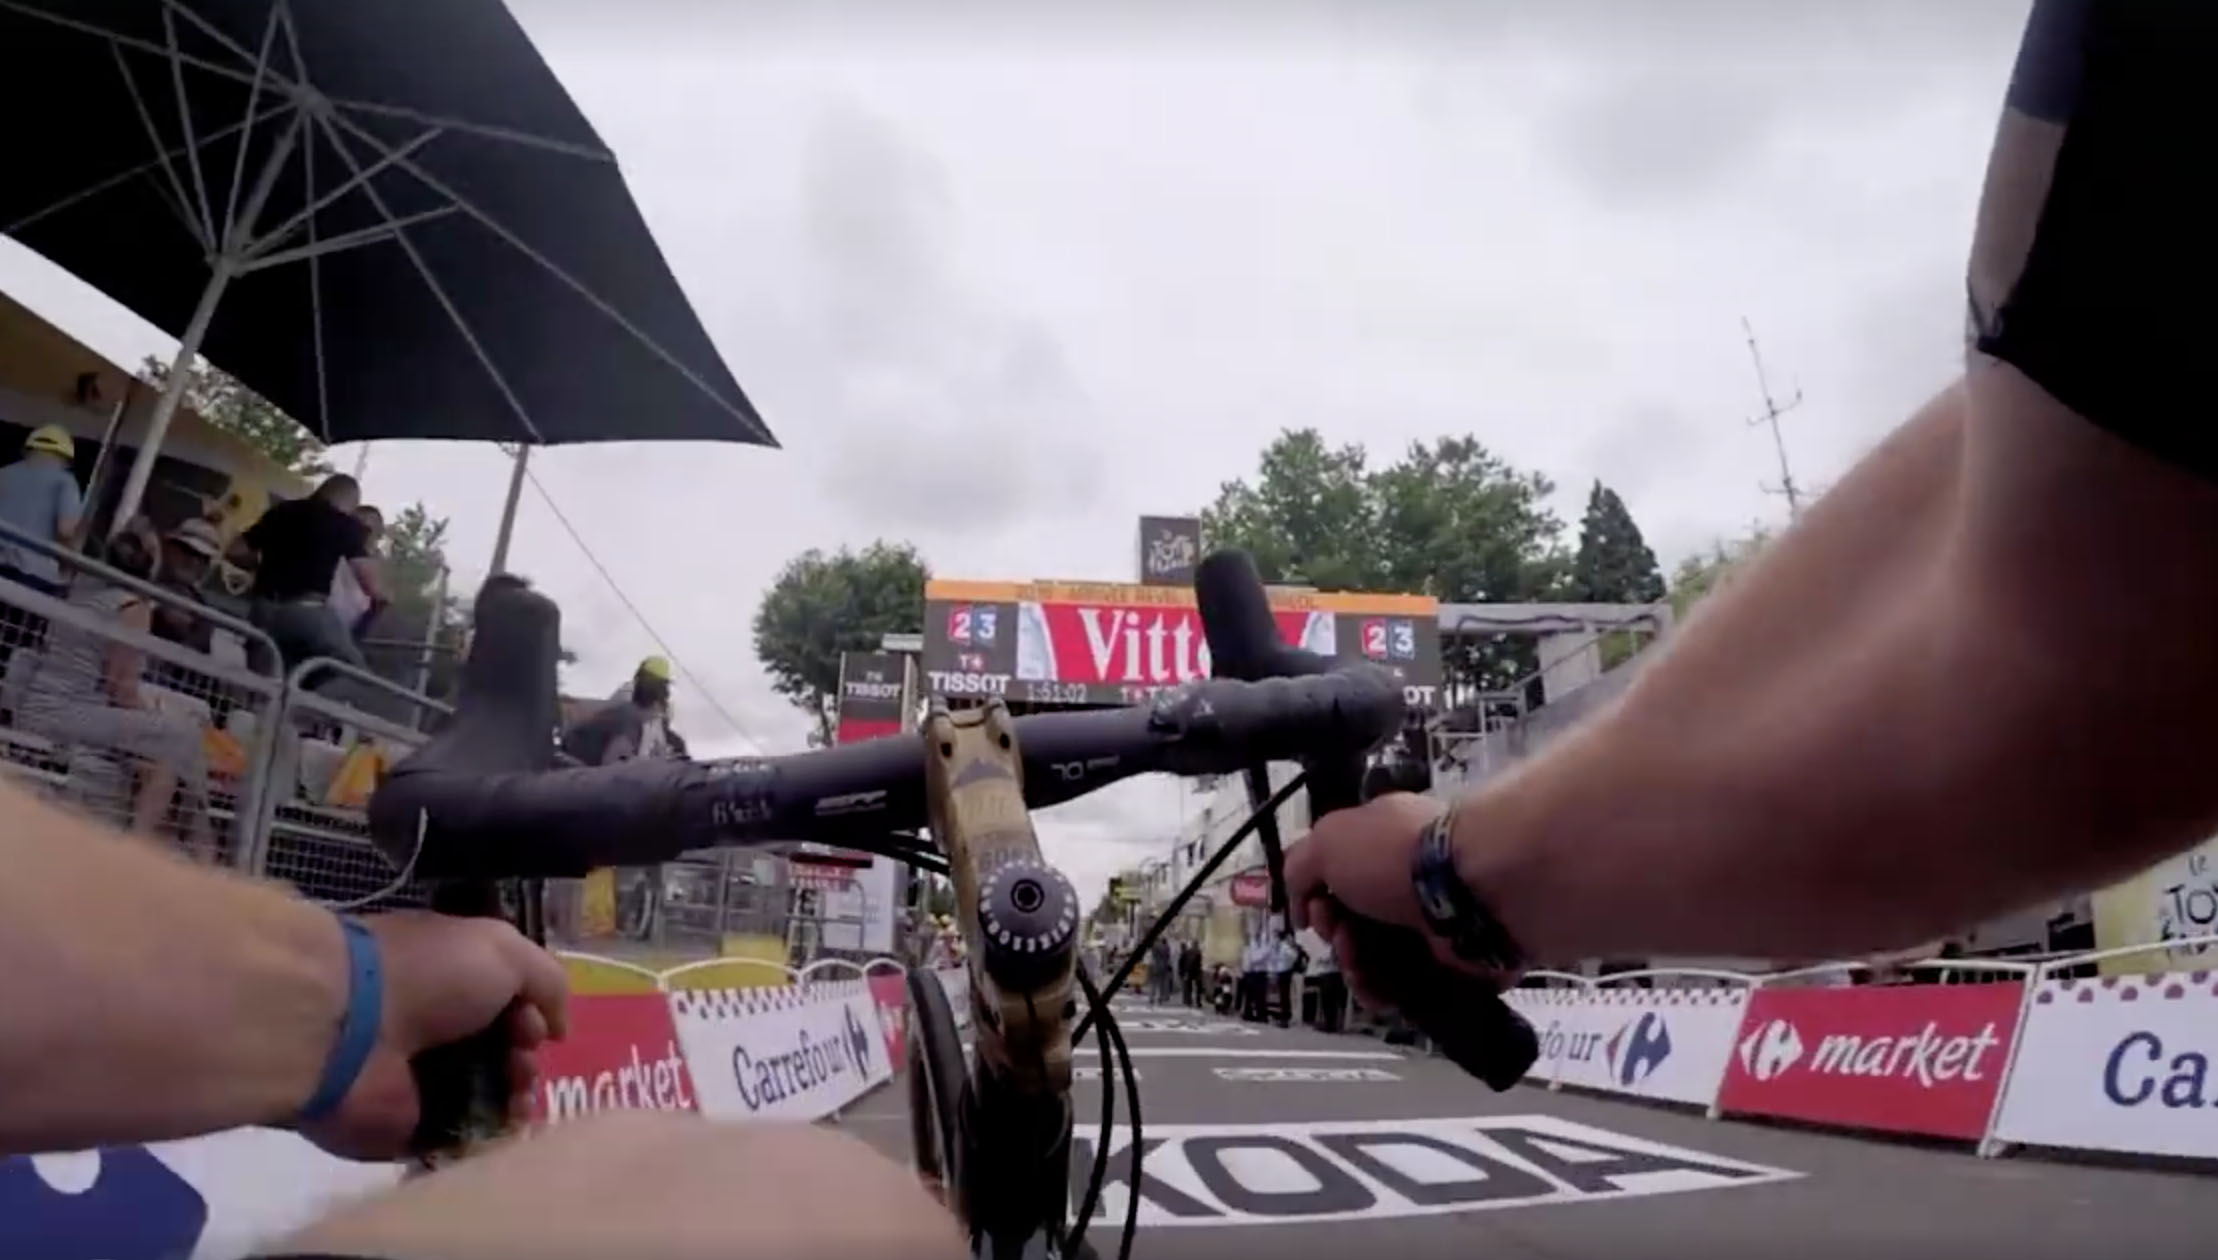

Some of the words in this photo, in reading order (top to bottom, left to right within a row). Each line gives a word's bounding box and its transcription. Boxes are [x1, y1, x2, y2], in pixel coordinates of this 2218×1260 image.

[845, 682, 901, 698] TISSOT
[928, 672, 1010, 694] TISSOT
[1402, 685, 1436, 706] OT
[733, 1029, 842, 1111] Carrefour
[1540, 1019, 1602, 1061] four
[1809, 1021, 1999, 1088] market
[2104, 1031, 2218, 1108] Ca
[546, 1040, 692, 1124] market
[1070, 1128, 1772, 1217] KODA
